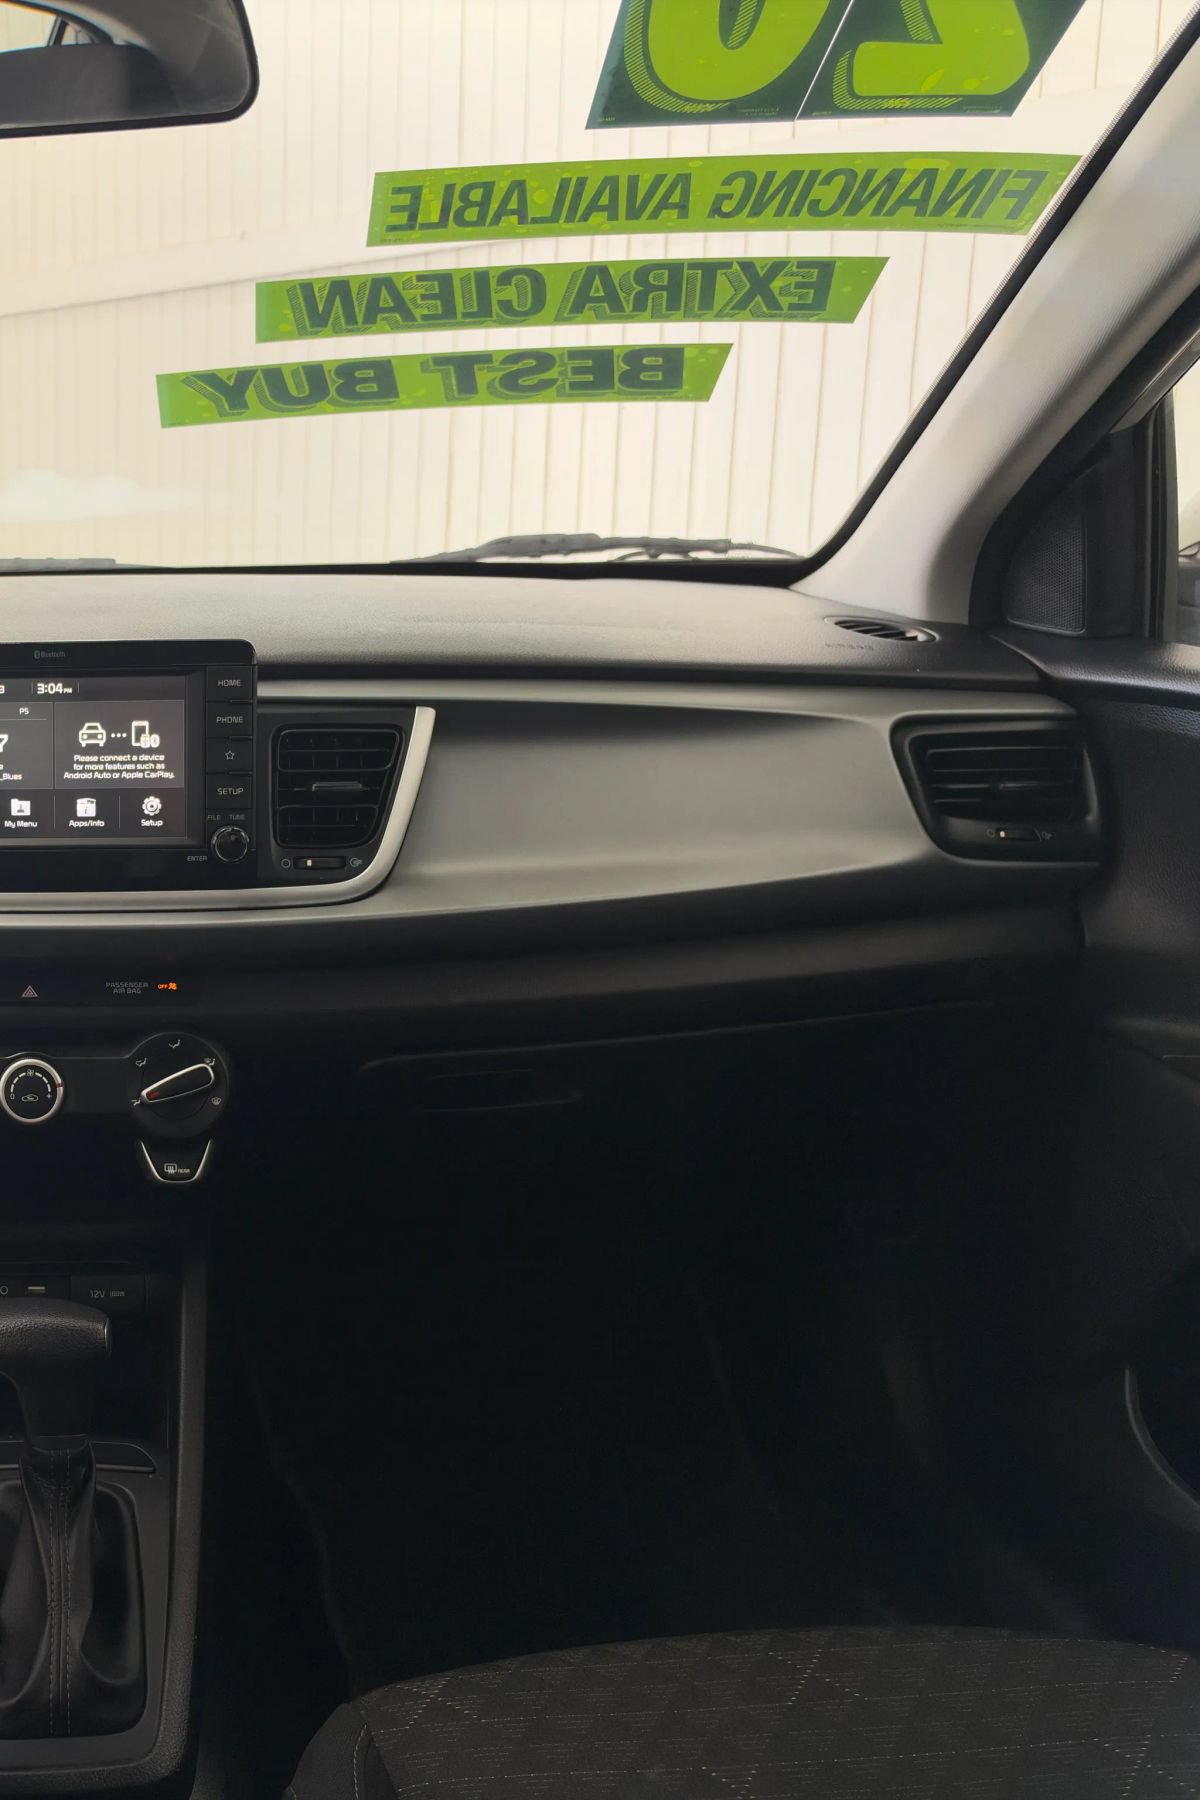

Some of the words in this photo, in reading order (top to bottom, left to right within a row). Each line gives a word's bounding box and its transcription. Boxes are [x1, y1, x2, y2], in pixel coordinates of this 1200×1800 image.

[218, 679, 241, 687] HOME
[216, 715, 244, 724] PHONE
[73, 754, 98, 762] Please
[139, 754, 165, 762] device
[73, 763, 83, 771] for
[105, 763, 135, 771] features
[136, 762, 155, 770] such
[63, 771, 92, 780] Android
[93, 771, 111, 780] Auto
[121, 771, 143, 780] Apple
[144, 771, 175, 780] CarPlay.
[217, 787, 244, 795] SETUP
[4, 820, 16, 829] My
[16, 820, 38, 828] Menu
[68, 819, 105, 828] Apps/Info
[140, 818, 164, 827] Setup
[90, 1290, 105, 1298] 12V
